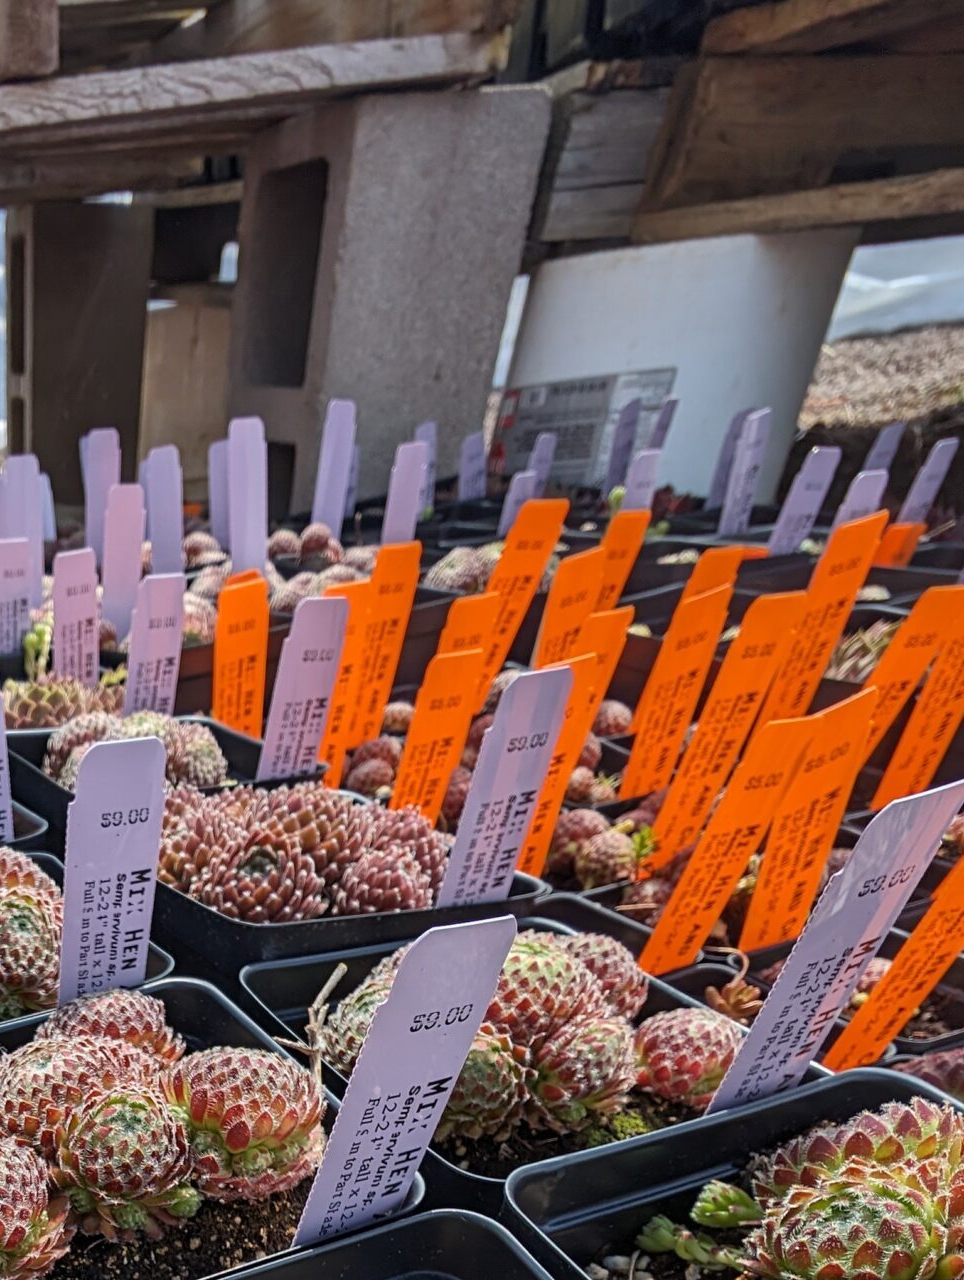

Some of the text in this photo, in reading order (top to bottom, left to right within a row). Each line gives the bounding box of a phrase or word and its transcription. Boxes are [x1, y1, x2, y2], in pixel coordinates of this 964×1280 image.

[99, 807, 150, 828] $9.00
[492, 847, 517, 888] HEN
[84, 881, 95, 904] Full
[857, 865, 917, 898] $9.00
[81, 932, 90, 942] to
[94, 932, 106, 955] tall
[79, 945, 90, 967] Part
[121, 929, 144, 970] HEN
[93, 960, 101, 968] x
[795, 961, 819, 989] Full
[409, 1003, 474, 1033] $9.00
[771, 1022, 782, 1033] to
[777, 1019, 799, 1044] tall
[795, 1006, 840, 1056] HEN
[755, 1037, 777, 1060] Part
[769, 1050, 780, 1060] x
[360, 1097, 381, 1125] Full
[343, 1157, 355, 1170] to
[354, 1156, 374, 1183] tall
[381, 1147, 422, 1197] HEN
[333, 1172, 352, 1197] Part
[348, 1188, 360, 1199] x
